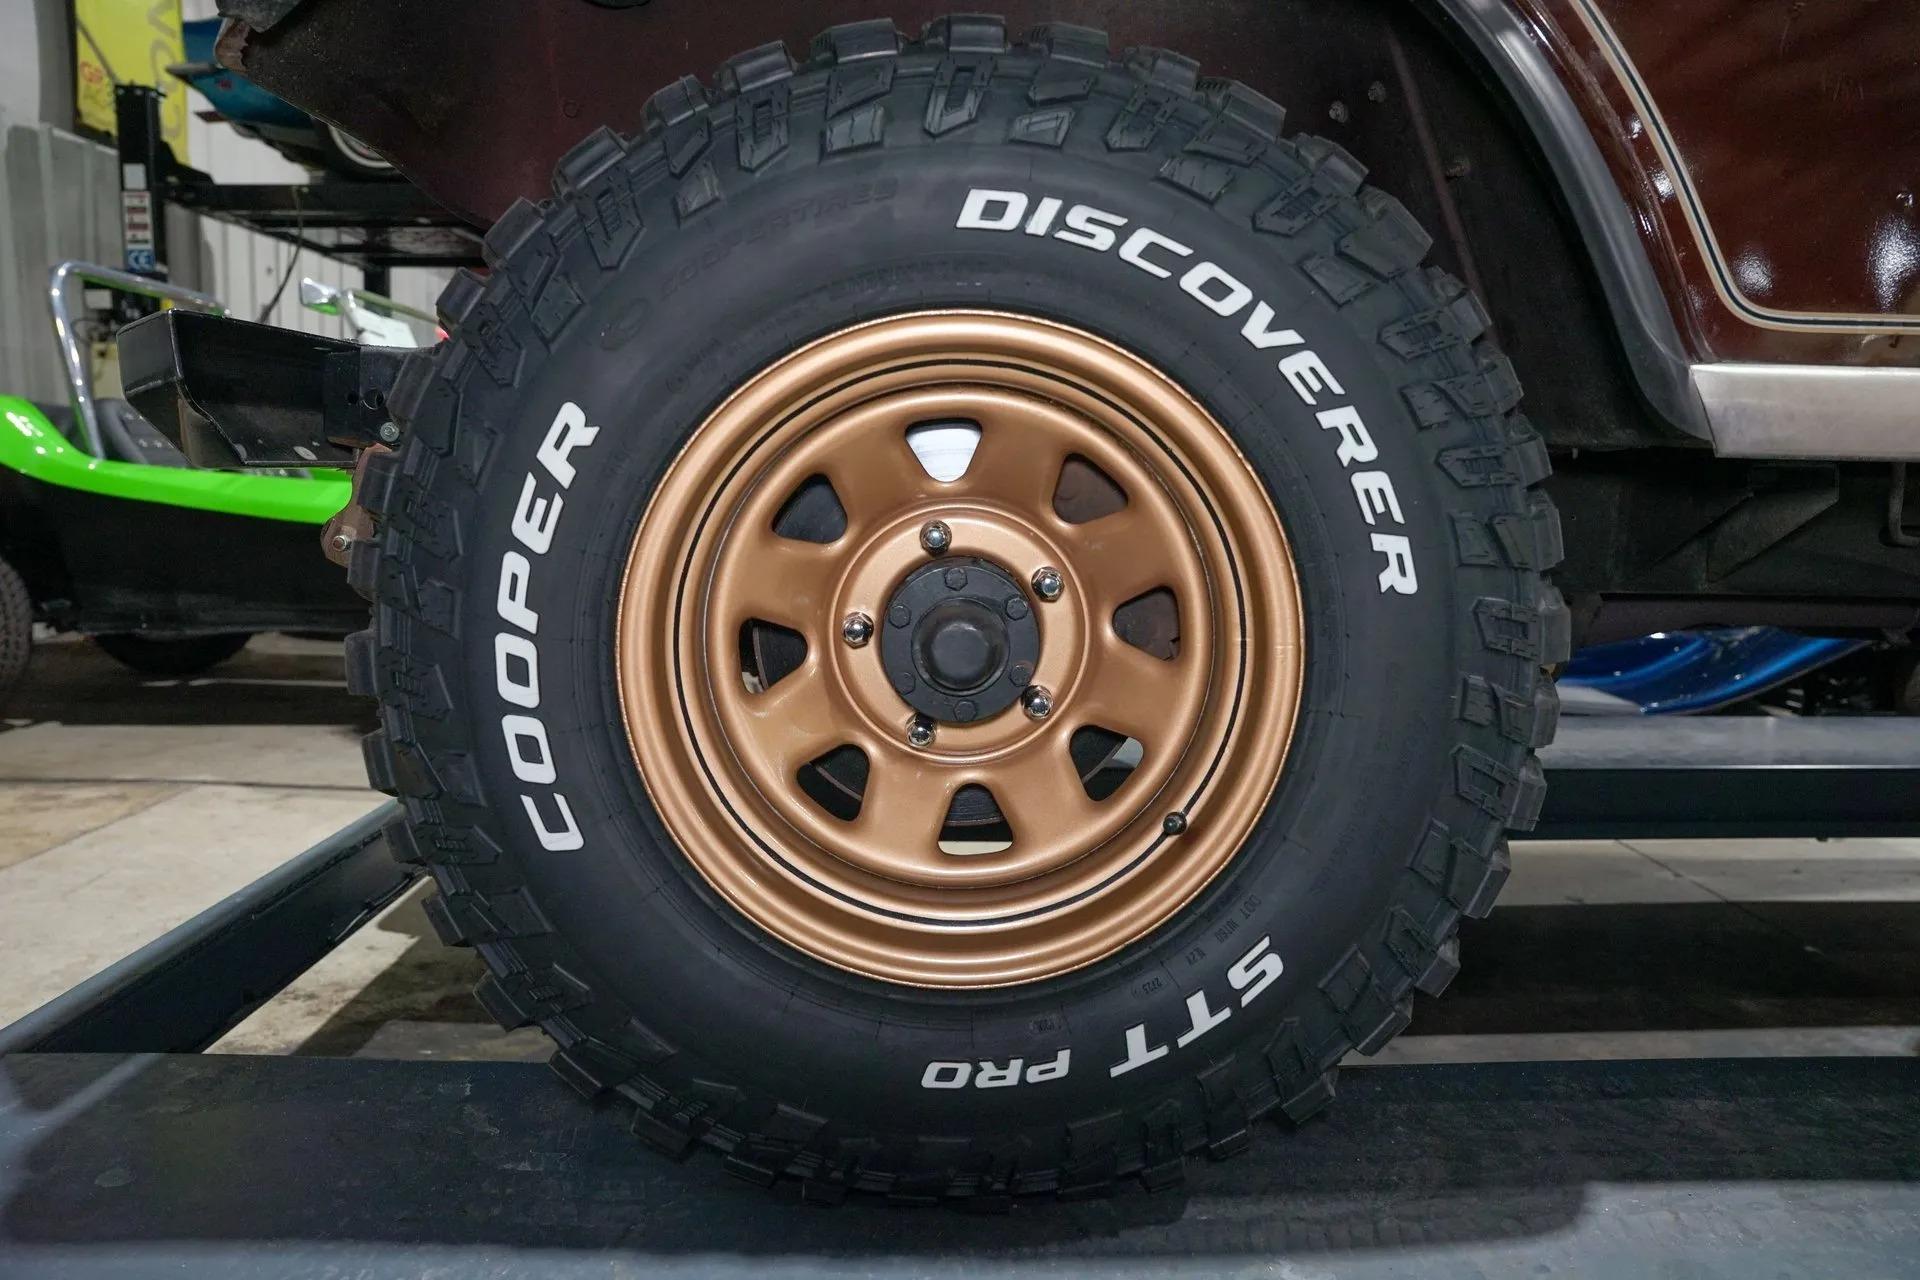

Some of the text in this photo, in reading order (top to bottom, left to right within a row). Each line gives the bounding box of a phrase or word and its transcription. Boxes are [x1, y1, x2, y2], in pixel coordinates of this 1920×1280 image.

[955, 188, 1418, 596] DISCOVERER
[494, 401, 600, 852] COOPER
[921, 936, 1284, 1089] STT PRO
